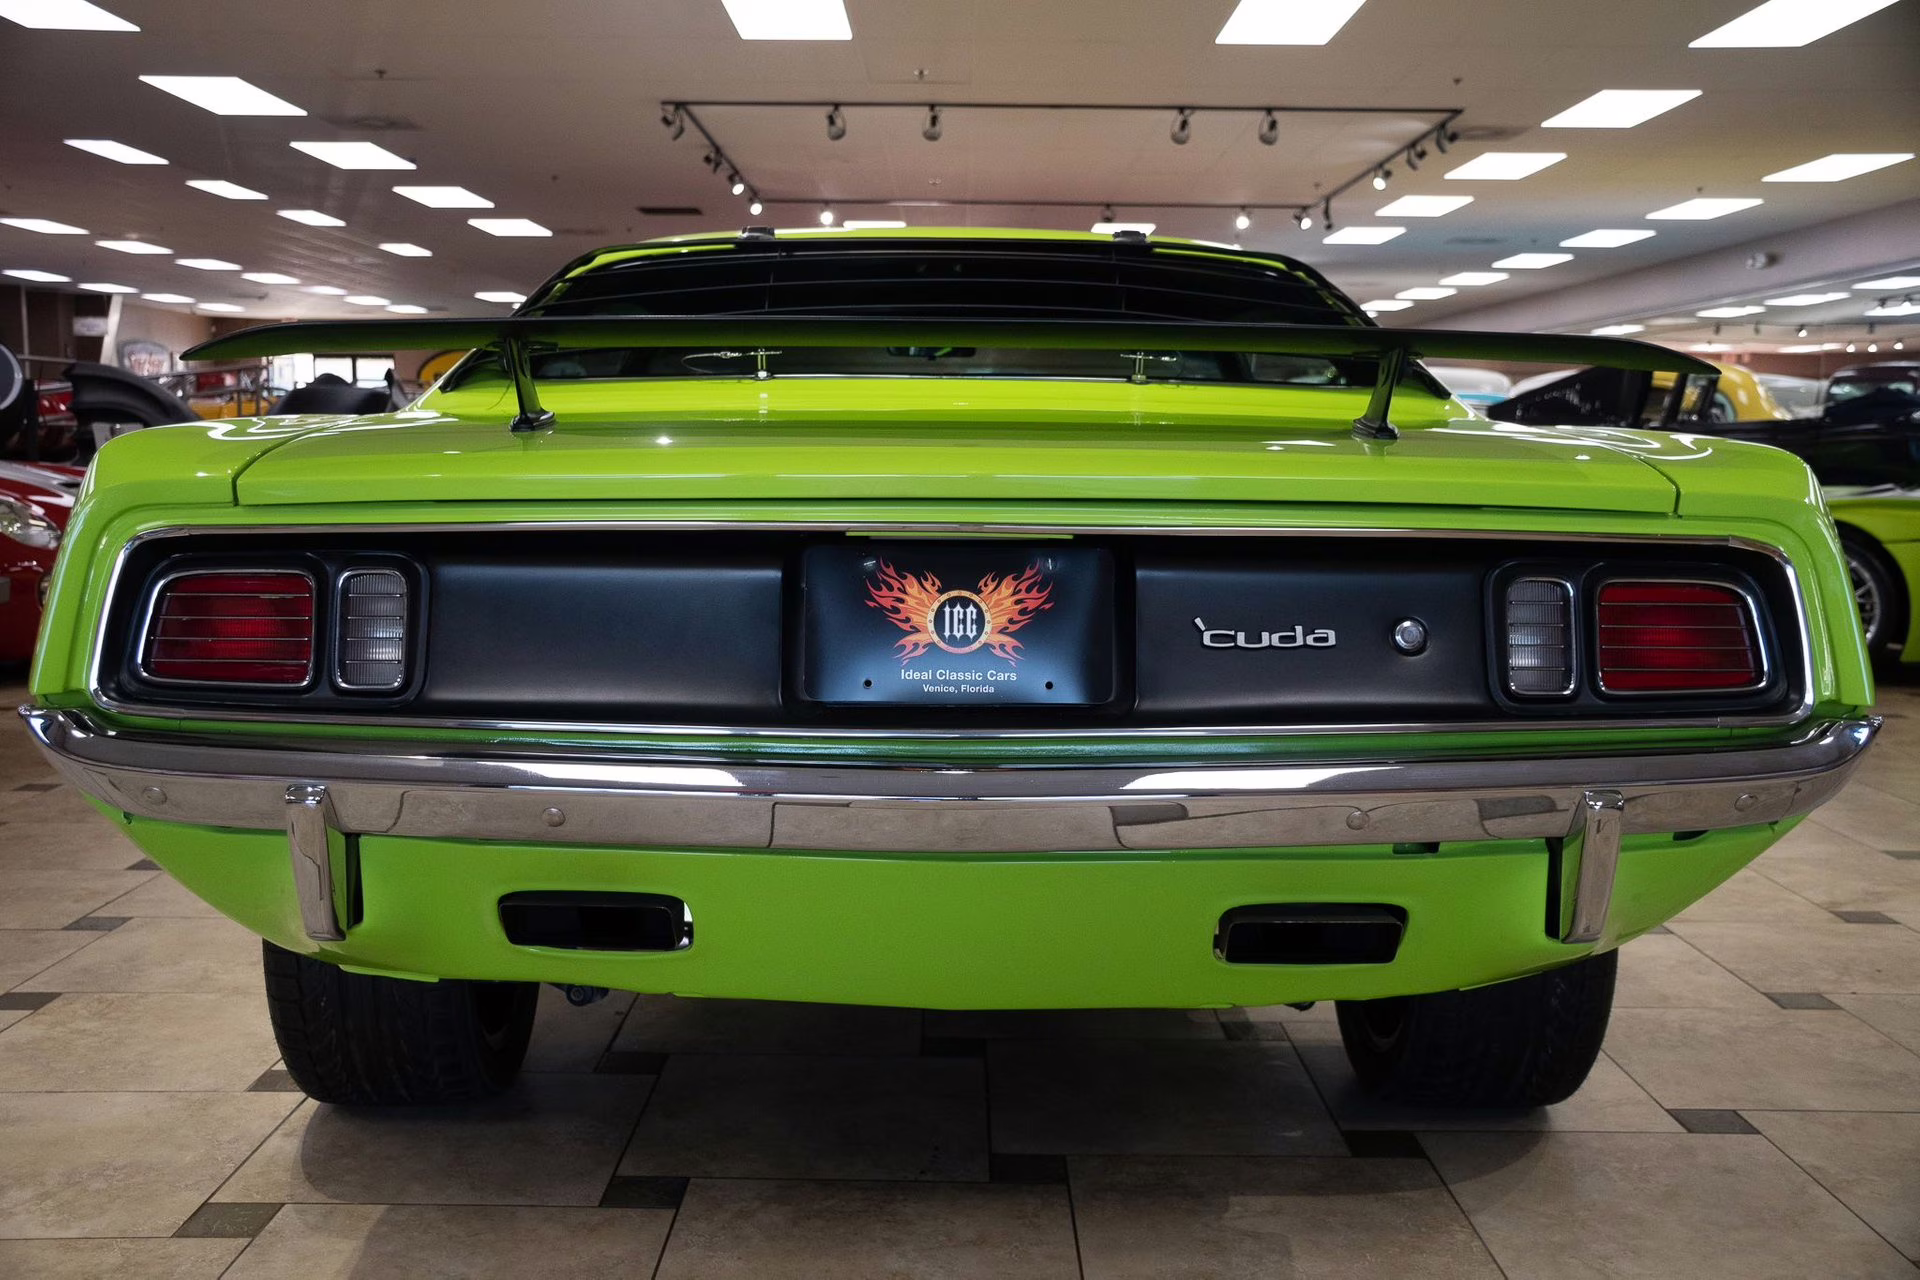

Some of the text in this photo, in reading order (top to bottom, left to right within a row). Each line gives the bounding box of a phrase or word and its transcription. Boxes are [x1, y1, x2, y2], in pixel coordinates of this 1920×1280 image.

[901, 669, 1017, 681] Ideal Classic Cars
[922, 684, 995, 694] Venice, Florida
